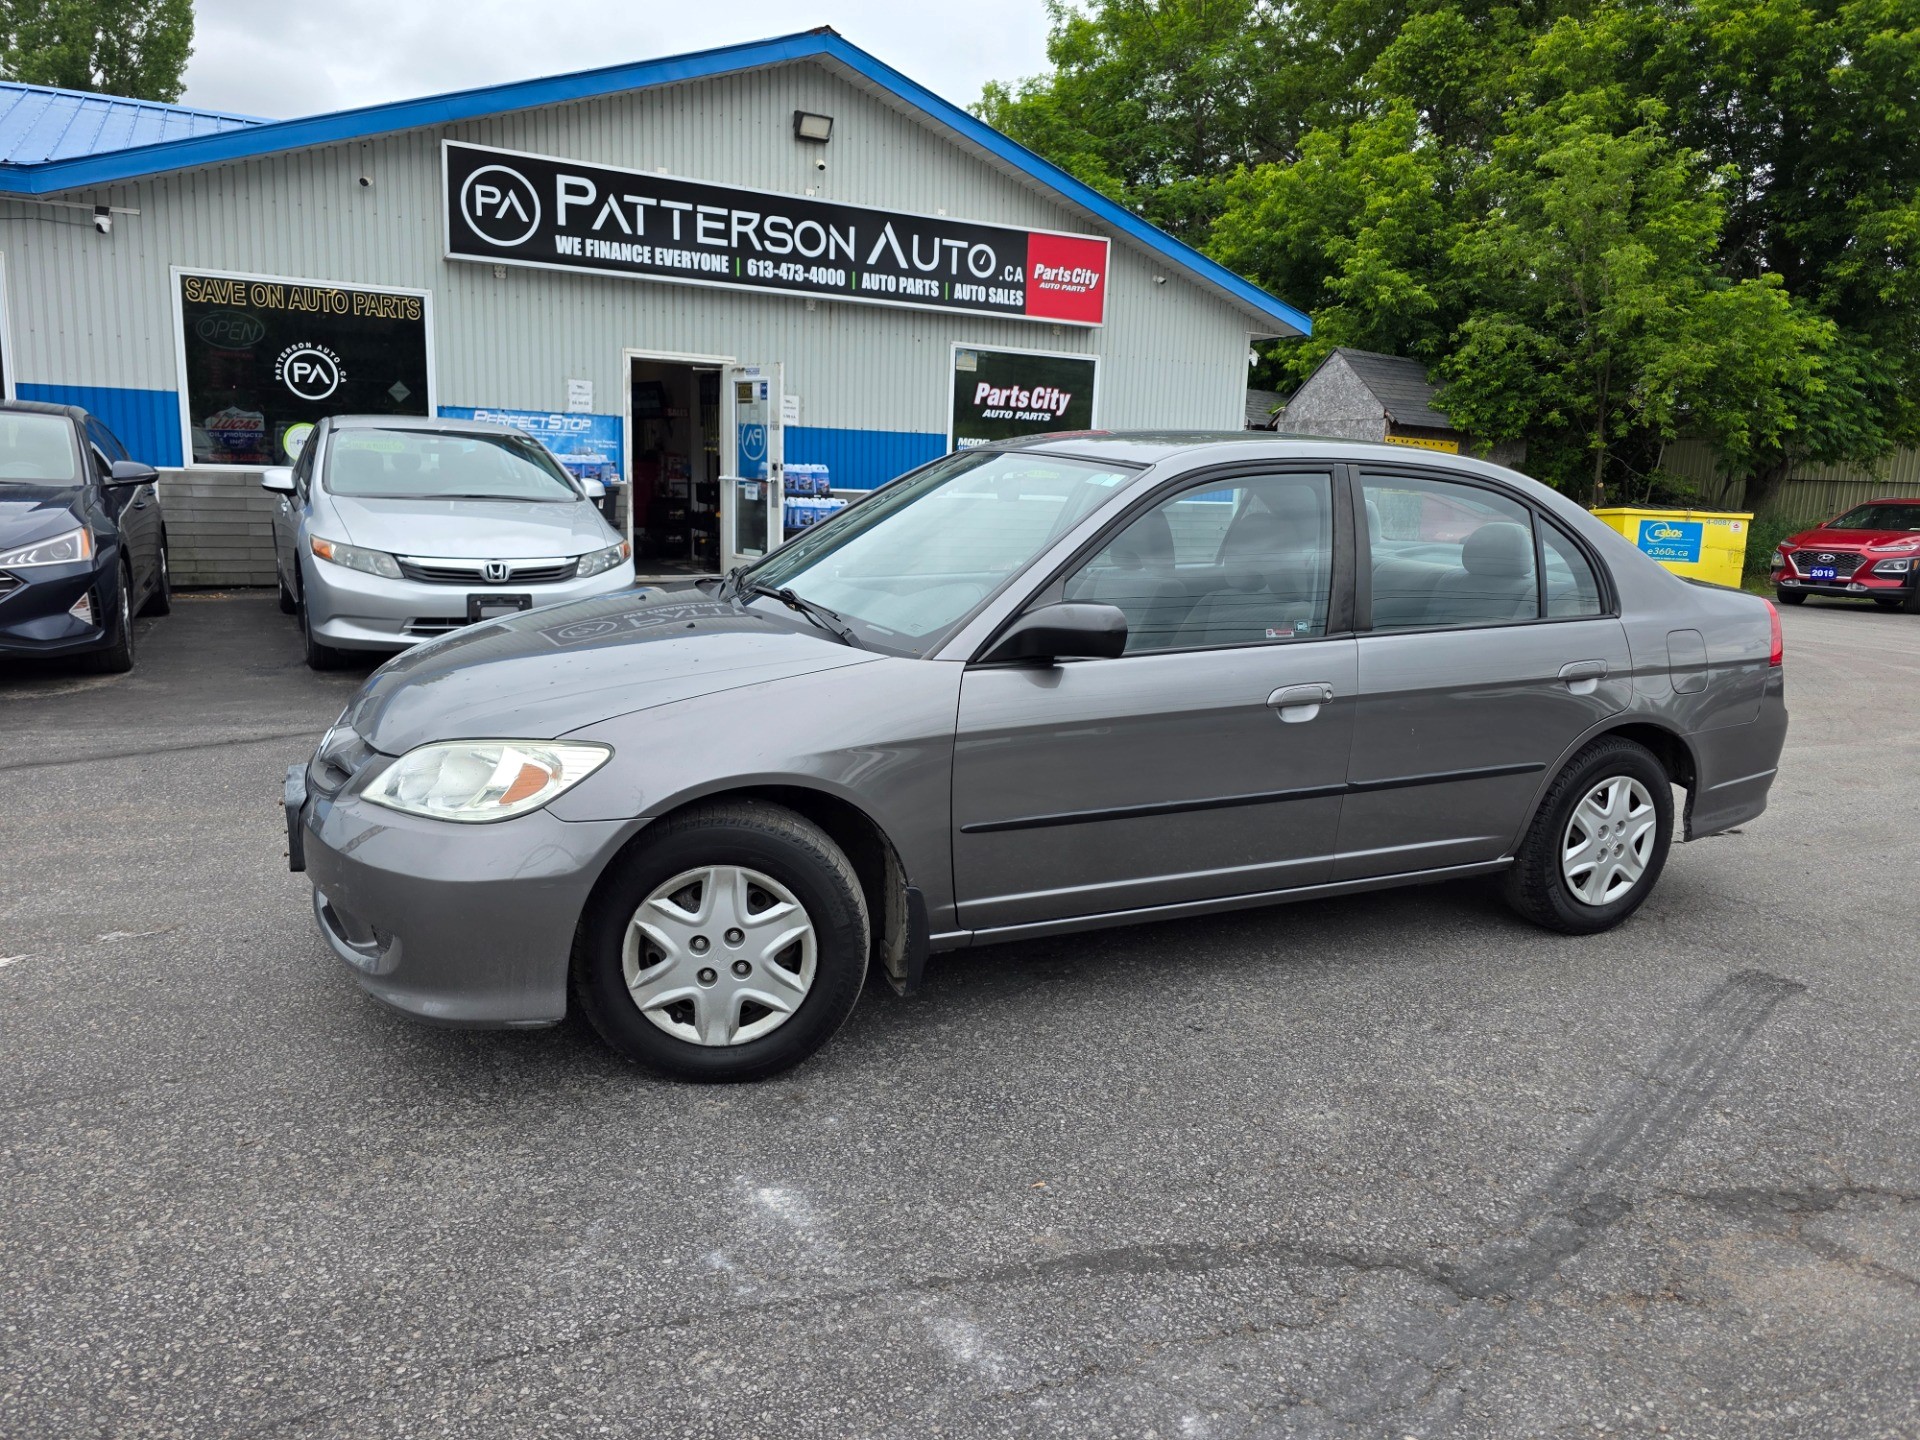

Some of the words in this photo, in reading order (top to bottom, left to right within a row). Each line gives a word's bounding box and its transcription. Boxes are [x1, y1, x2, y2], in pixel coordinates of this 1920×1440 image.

[475, 184, 530, 223] PA
[556, 173, 856, 262] PATTERSON
[555, 234, 582, 255] WE
[585, 239, 651, 264] FINANCE
[655, 247, 730, 273] EVERYONE
[747, 258, 846, 286] 613-473-4000
[862, 272, 896, 292] AUTO
[899, 278, 939, 297] PARTS
[953, 283, 985, 302] AUTO
[988, 287, 1024, 306] SALES
[1039, 282, 1060, 290] AUTO
[1061, 284, 1086, 293] PARTS
[185, 278, 247, 306] SAVE
[251, 283, 285, 309] ON
[288, 287, 349, 314] AUTO
[353, 293, 421, 320] PARTS
[199, 319, 260, 341] OPEN
[275, 342, 312, 380] PATTERSON
[293, 362, 331, 384] PA
[211, 419, 261, 430] LUCAS
[982, 409, 1013, 419] AUTO
[1015, 411, 1051, 421] PARTS
[1387, 438, 1456, 447] QUALITY
[1647, 546, 1689, 557] e360s.ca
[1811, 569, 1834, 577] 2019
